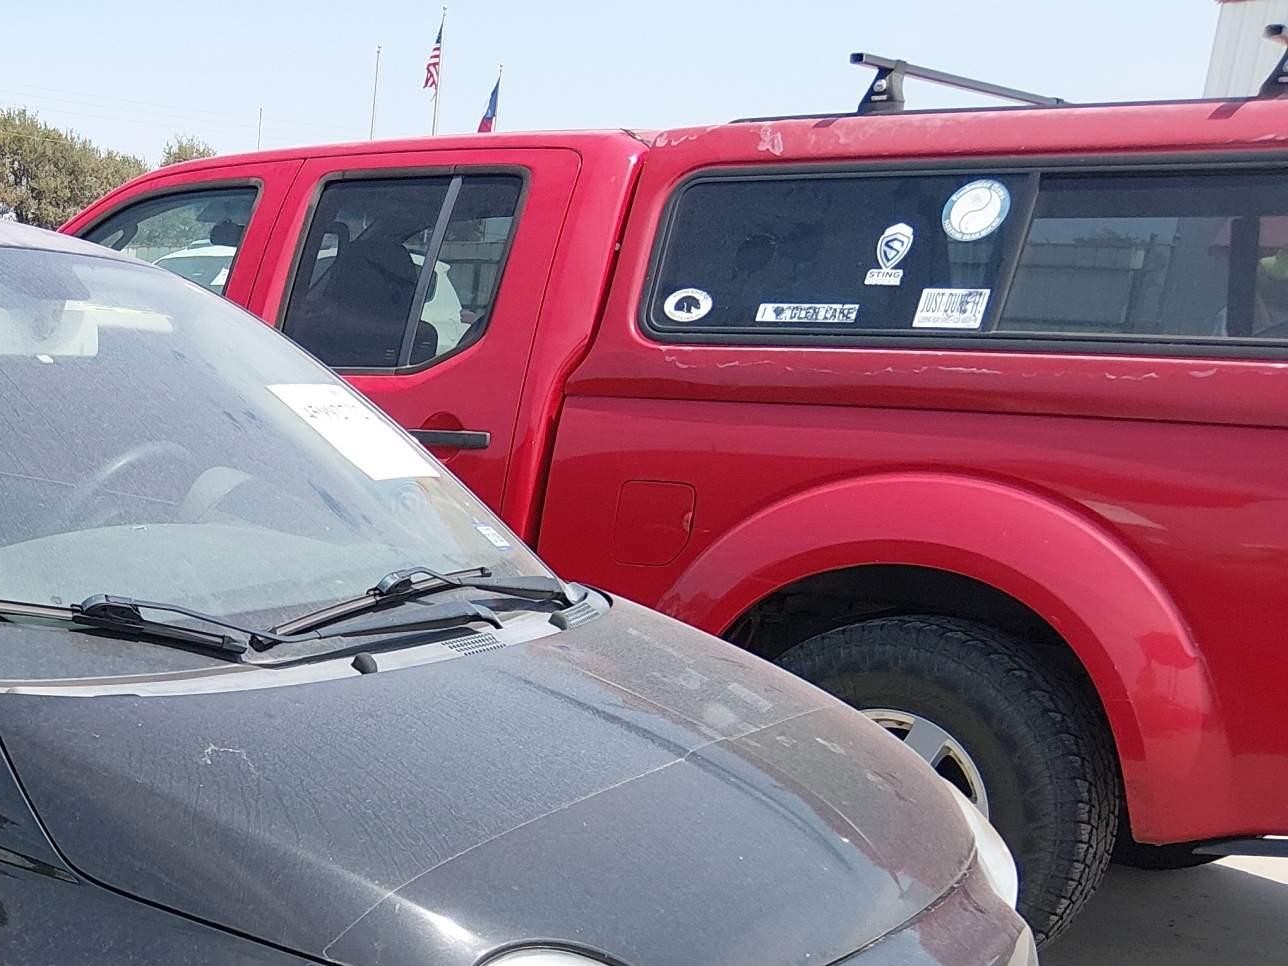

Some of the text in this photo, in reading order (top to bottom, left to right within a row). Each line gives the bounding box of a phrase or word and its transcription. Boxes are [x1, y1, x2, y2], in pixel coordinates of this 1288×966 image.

[867, 271, 901, 279] STING
[920, 291, 946, 313] JUST
[789, 306, 821, 321] GLEN
[822, 306, 857, 321] LAKE
